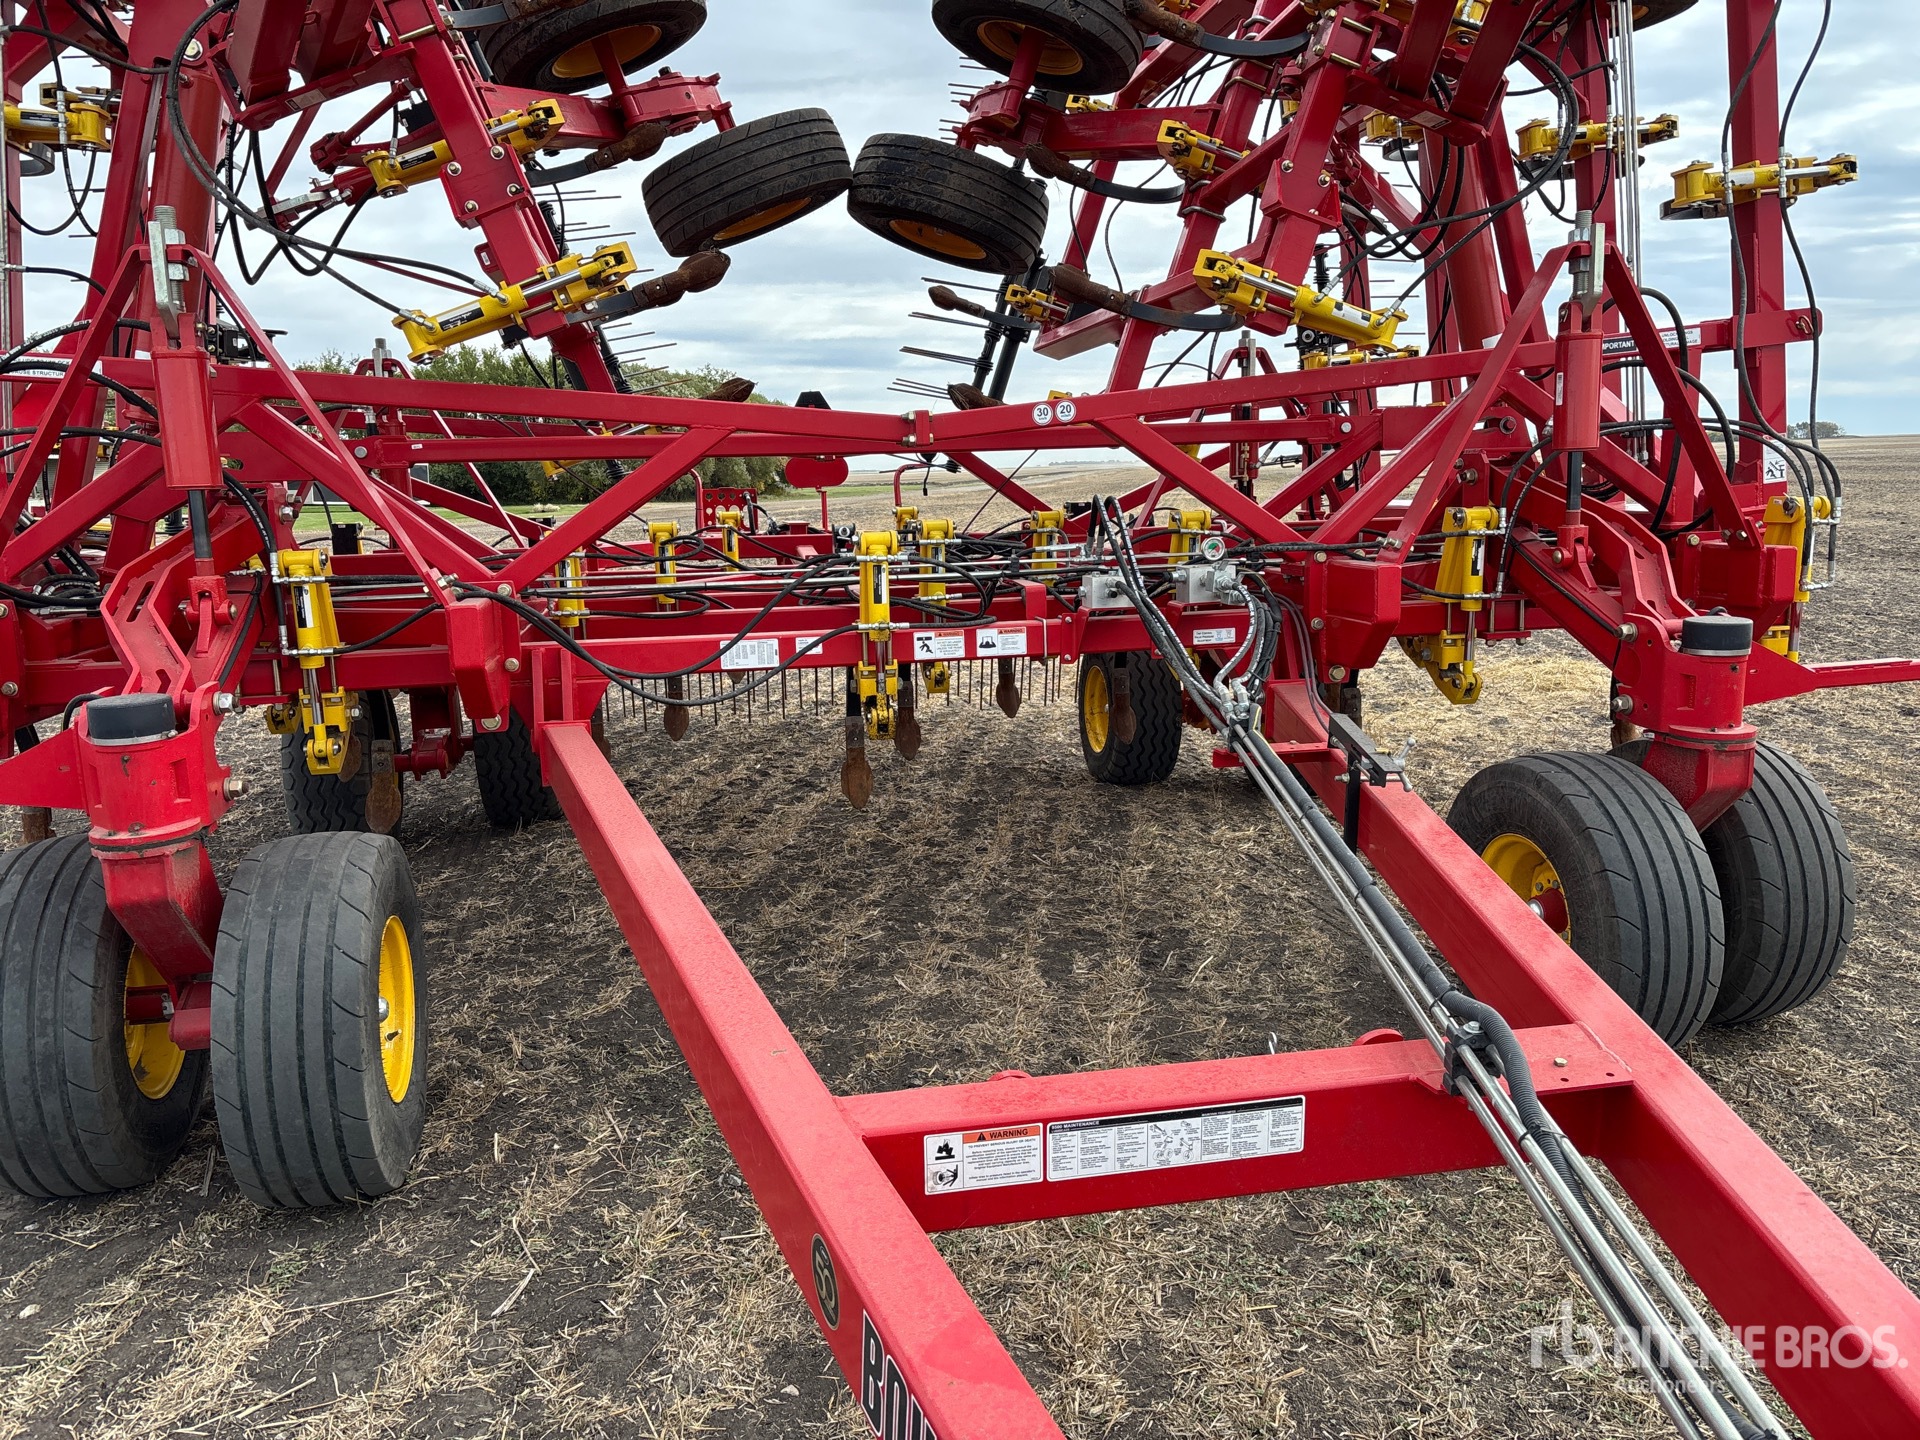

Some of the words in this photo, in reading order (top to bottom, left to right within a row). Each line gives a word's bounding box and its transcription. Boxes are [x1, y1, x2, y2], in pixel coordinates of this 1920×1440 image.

[1037, 407, 1049, 416] 30
[1060, 405, 1071, 414] 20
[1063, 1120, 1100, 1129] MAINTENANCE
[989, 1128, 1028, 1139] WARNING
